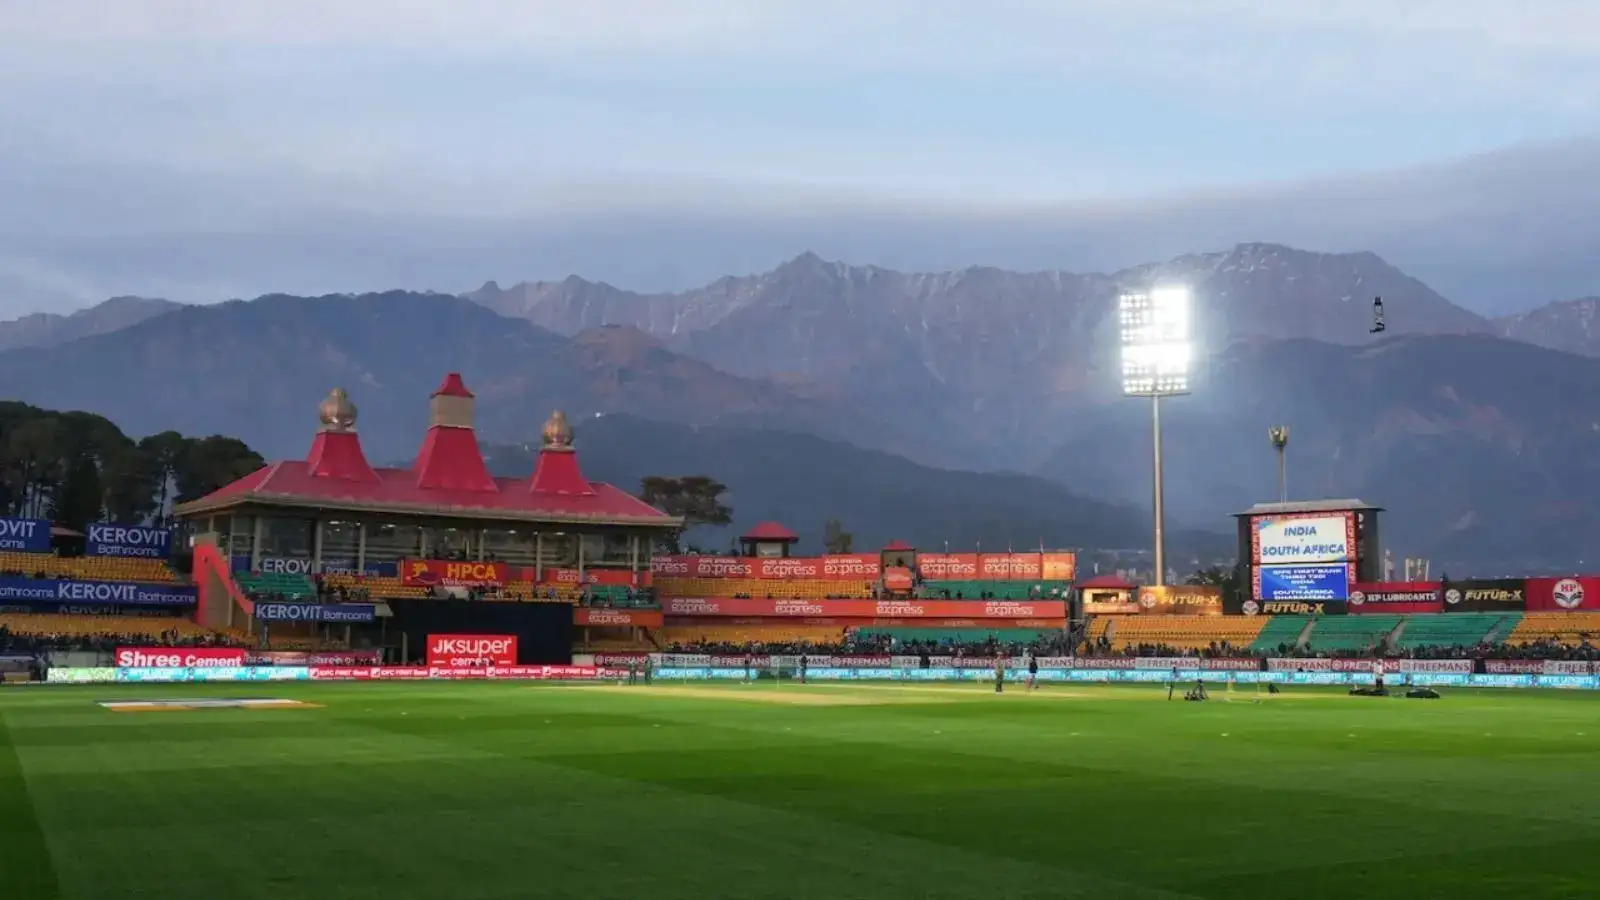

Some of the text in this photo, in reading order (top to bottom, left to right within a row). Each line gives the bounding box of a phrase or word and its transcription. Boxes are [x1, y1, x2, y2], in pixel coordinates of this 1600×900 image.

[89, 526, 168, 545] KEROVIT
[1284, 526, 1317, 536] INDIA
[98, 544, 159, 556] Bathrooms
[1263, 544, 1345, 556] SOUTH AFRICA
[258, 558, 312, 573] EROV
[447, 563, 496, 579] HPCA
[650, 562, 688, 573] press
[698, 563, 752, 576] express
[762, 565, 816, 577] express
[824, 563, 878, 575] express
[921, 563, 976, 575] express
[984, 563, 1039, 575] express
[58, 583, 137, 600] KEROVIT
[138, 592, 196, 603] Bathrooms
[1560, 584, 1576, 592] HP
[1368, 592, 1381, 601] HP
[1382, 592, 1436, 601] LUBRICANTS
[1464, 589, 1522, 601] FUTUR-X
[256, 605, 322, 619] KEROVIT
[672, 604, 719, 614] express
[775, 605, 823, 615] express
[876, 606, 924, 616] express
[986, 606, 1034, 616] express
[1263, 602, 1325, 615] FUTUR-X
[119, 651, 241, 667] Shree Cement
[721, 656, 770, 666] FREEANS
[841, 656, 891, 666] FREEMANS
[1085, 658, 1136, 668] FREEMANS
[1147, 658, 1199, 668] FREEMANS
[1212, 659, 1258, 669] FREEMAN
[1277, 659, 1330, 669] FREEMANS
[1413, 662, 1470, 672] FREEMANS
